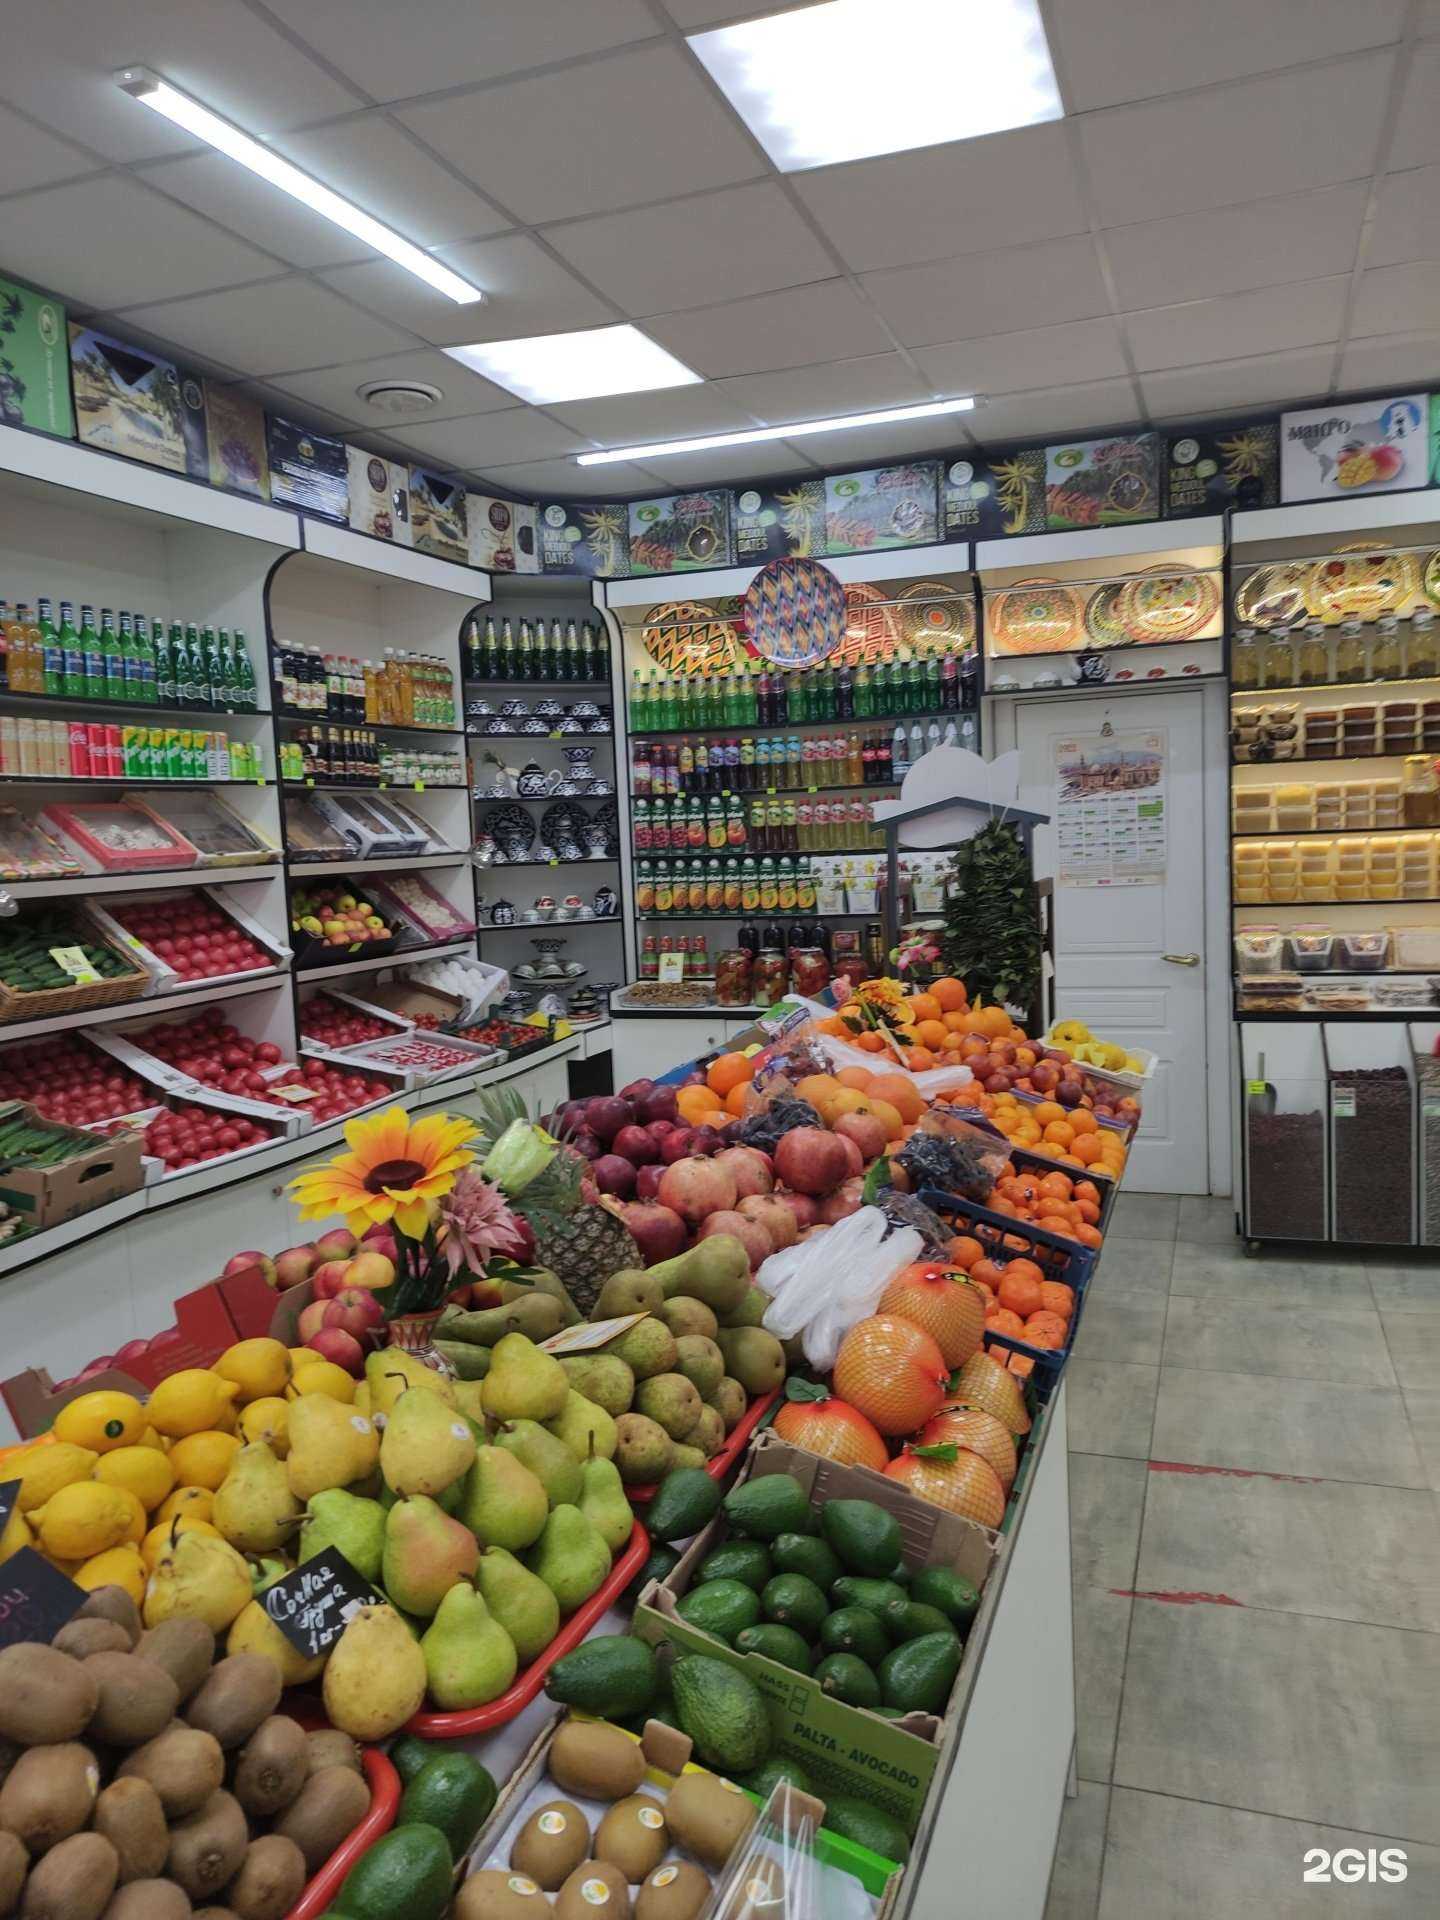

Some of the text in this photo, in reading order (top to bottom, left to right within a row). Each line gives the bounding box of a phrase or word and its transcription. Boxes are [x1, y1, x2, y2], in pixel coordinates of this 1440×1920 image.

[544, 551, 574, 565] DATES
[792, 1722, 837, 1751] PALTA
[848, 1752, 920, 1789] AVOCADO
